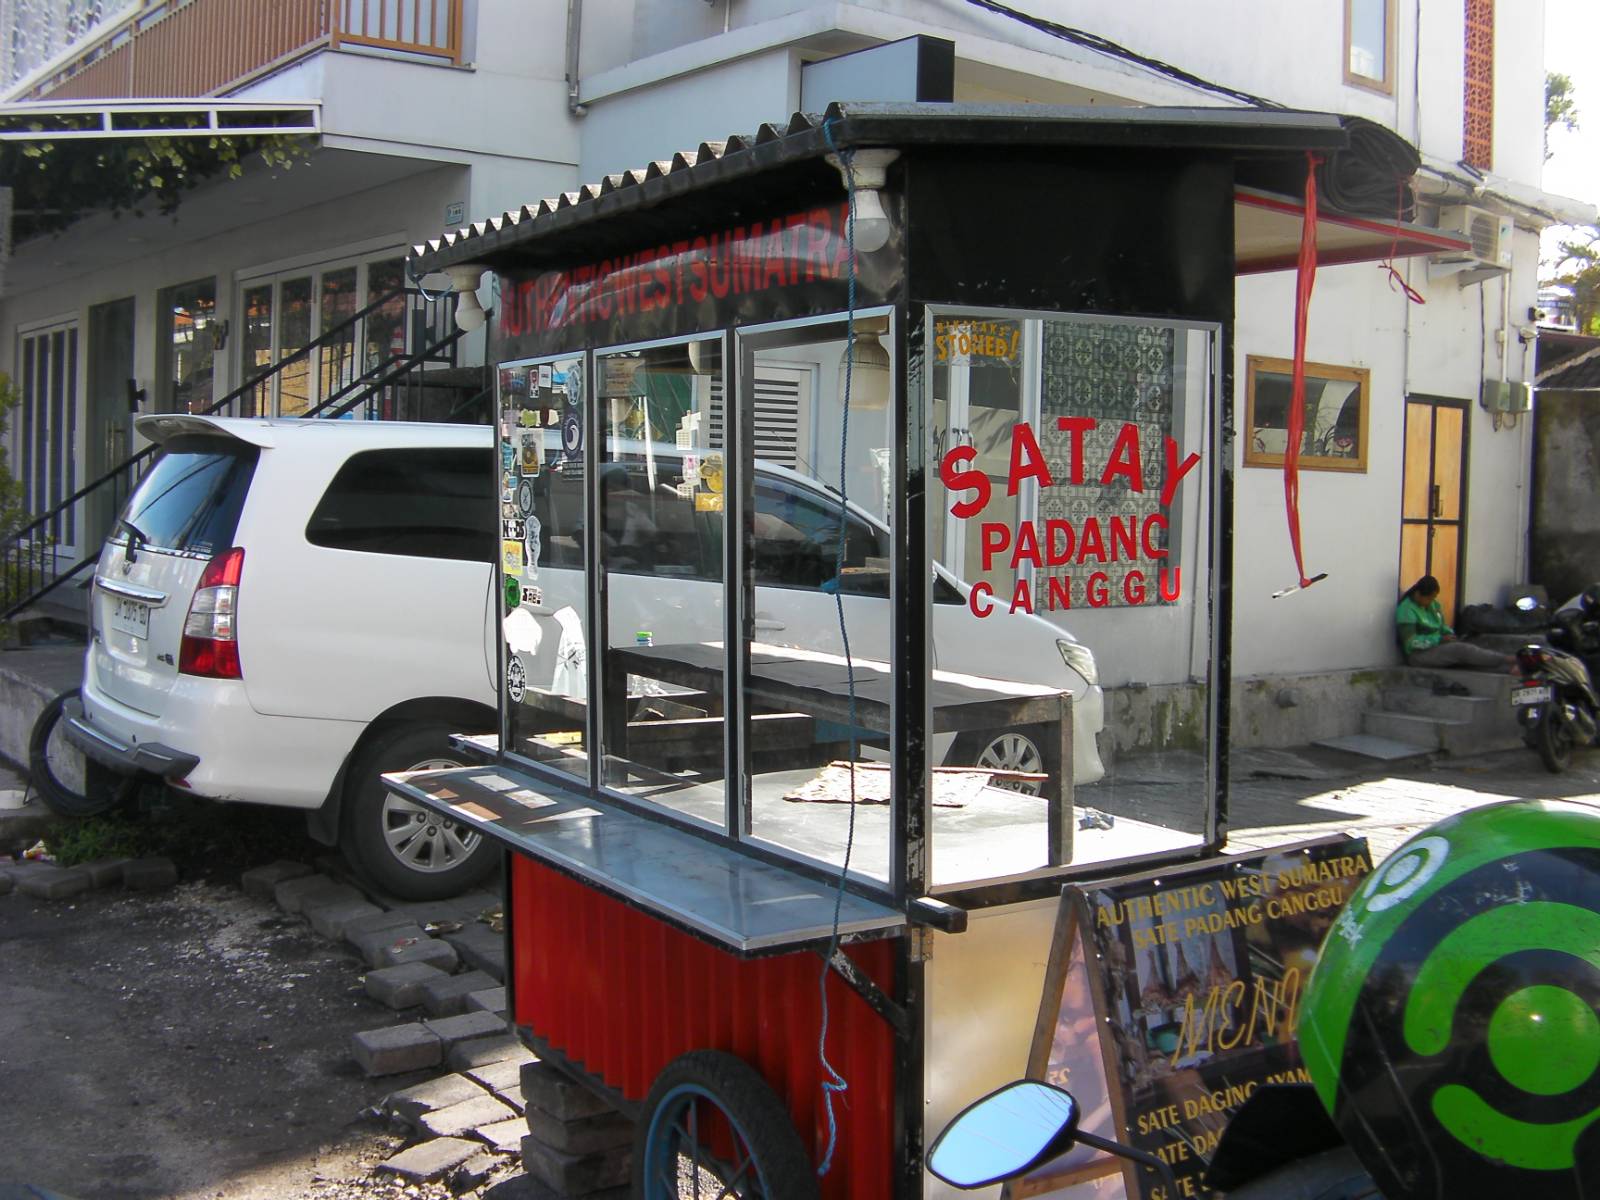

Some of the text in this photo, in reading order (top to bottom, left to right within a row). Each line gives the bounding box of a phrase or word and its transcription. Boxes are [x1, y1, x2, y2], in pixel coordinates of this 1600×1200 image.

[939, 416, 1201, 519] SATAY
[969, 566, 1182, 619] CANGGU
[1096, 854, 1369, 928] AUTHENTIC WEST SUMATRA
[1134, 886, 1344, 949] SATE PADANG CANGGU
[1137, 1104, 1181, 1136] SATE
